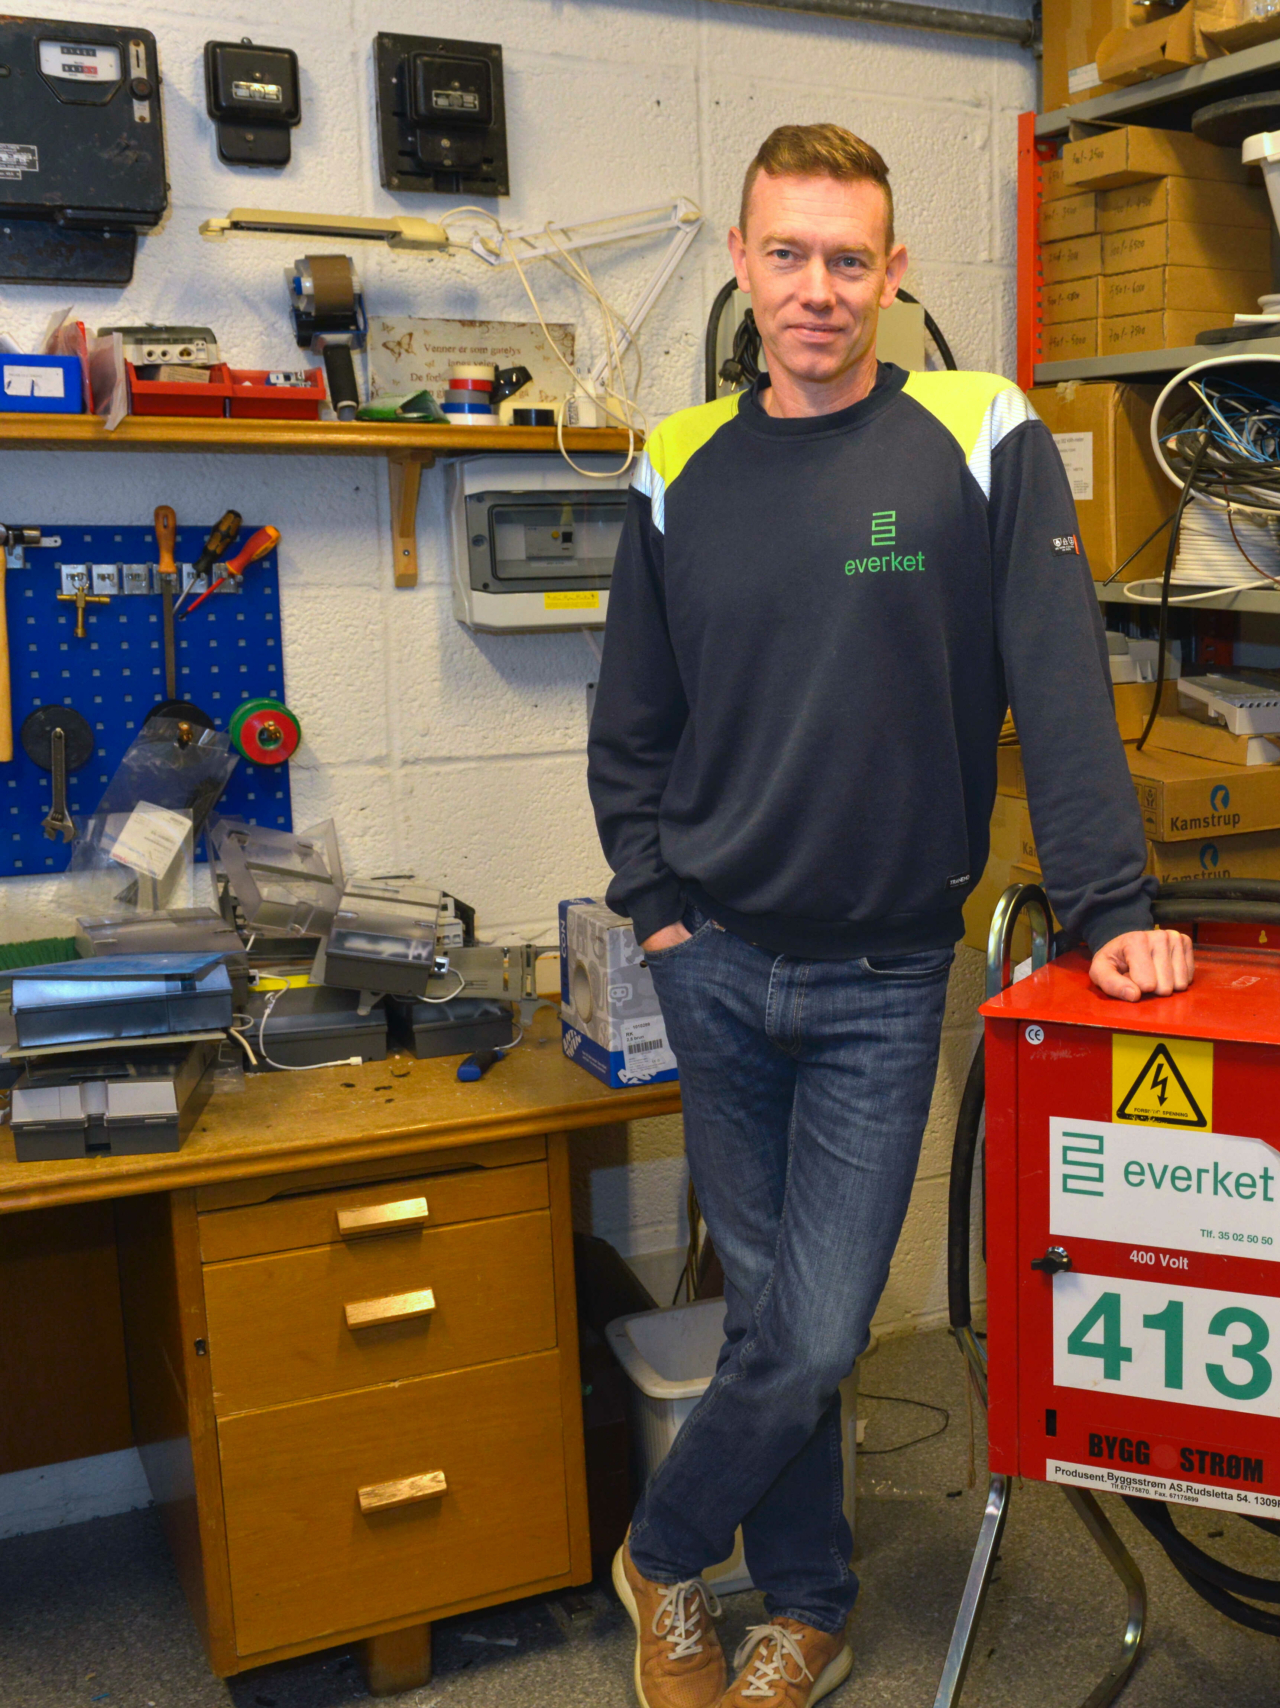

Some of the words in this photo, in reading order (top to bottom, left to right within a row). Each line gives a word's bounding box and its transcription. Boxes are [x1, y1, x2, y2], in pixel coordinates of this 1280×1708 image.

[424, 344, 456, 354] Venner
[458, 346, 467, 354] er
[470, 346, 489, 354] som
[844, 551, 926, 576] everket
[1171, 813, 1240, 832] Kamstrup
[1162, 1110, 1188, 1118] SPENNING
[1124, 1160, 1274, 1202] everket
[1200, 1229, 1215, 1239] Tlf.
[1218, 1231, 1230, 1240] 35
[1232, 1232, 1244, 1242] 02
[1246, 1234, 1259, 1244] 50
[1261, 1236, 1273, 1246] 50
[1130, 1250, 1156, 1265] 400
[1160, 1254, 1189, 1270] Volt
[1068, 1292, 1272, 1400] 413
[1088, 1433, 1150, 1466] BYGG
[1180, 1447, 1264, 1484] STRØM
[1054, 1466, 1107, 1483] Produsent.
[1107, 1472, 1166, 1490] Byggsstrøm
[1236, 1493, 1251, 1504] 54.
[1154, 1490, 1168, 1498] Fax.
